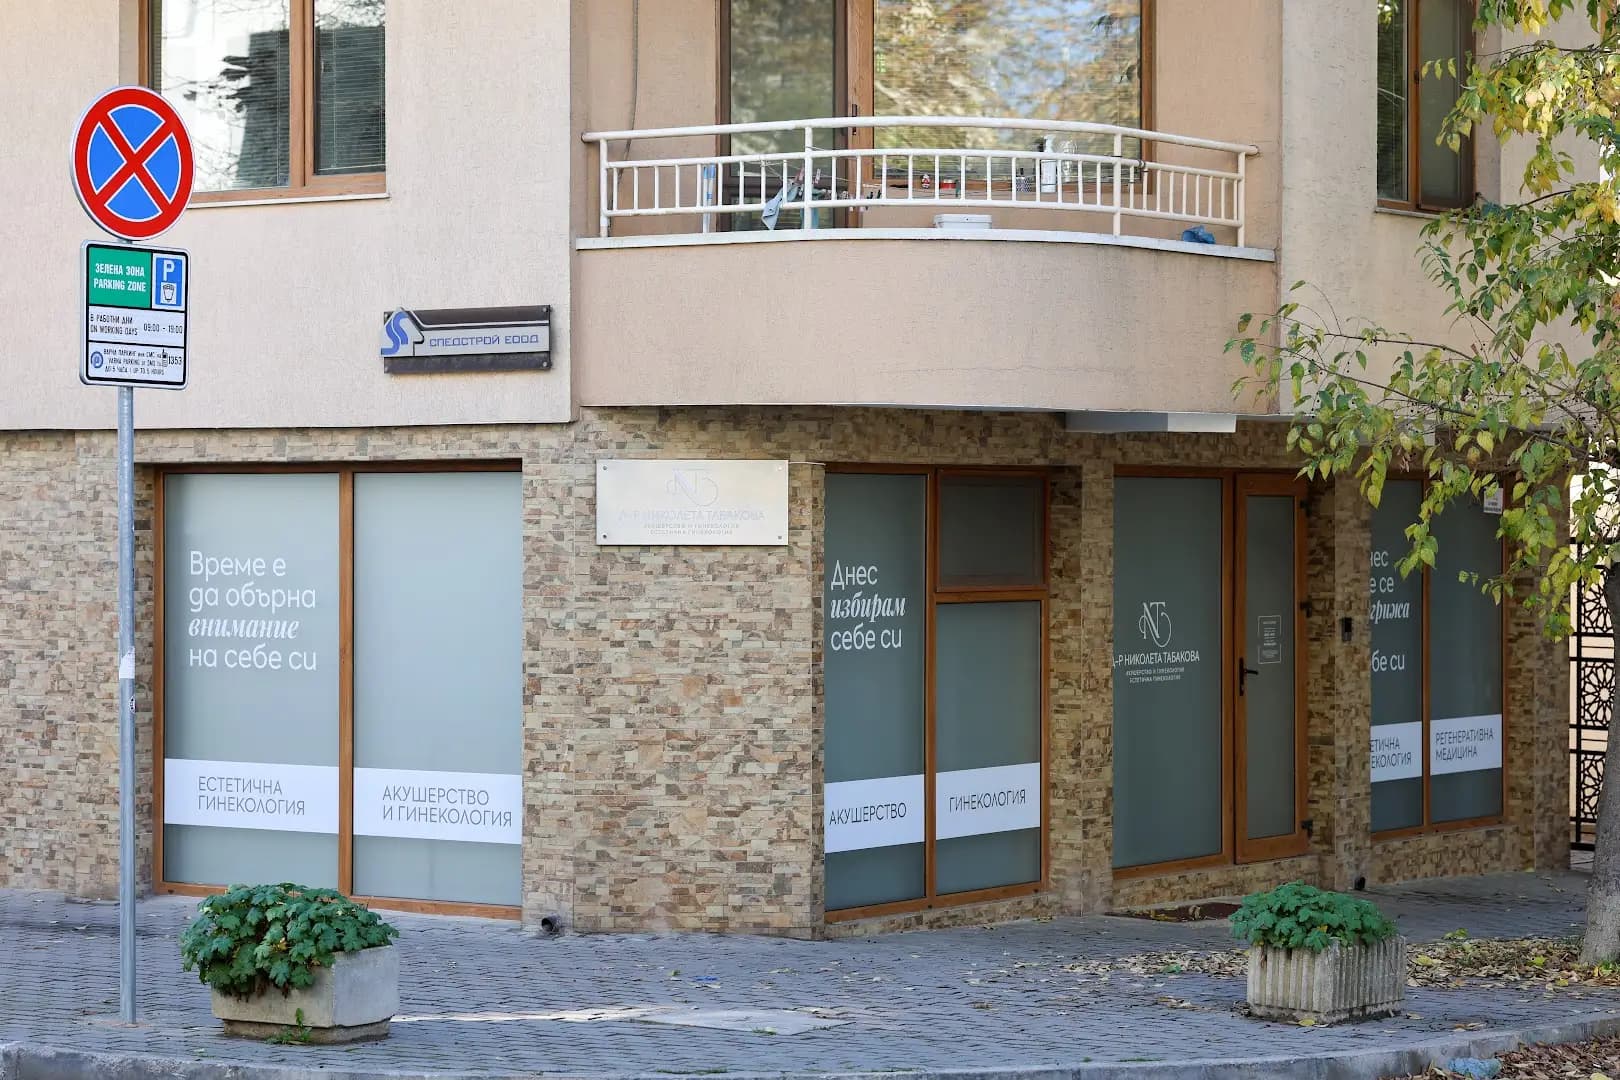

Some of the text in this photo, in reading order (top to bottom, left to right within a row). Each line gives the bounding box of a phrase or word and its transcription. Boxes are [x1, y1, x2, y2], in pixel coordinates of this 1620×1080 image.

[95, 263, 145, 277] ЗЕЛЕНА ЗОНА
[163, 260, 175, 282] P
[93, 278, 146, 292] PARKING ZONE
[96, 314, 120, 323] РАБОТНИ
[121, 316, 133, 324] ДНИ
[99, 325, 123, 335] WORKING
[124, 327, 138, 336] DAYS
[429, 334, 539, 347] СПЕДСТРОЙ ЕООД
[168, 355, 182, 365] 1353
[190, 550, 286, 582] Време е
[831, 559, 878, 591] Днес
[1380, 576, 1394, 593] се
[189, 581, 316, 614] да обърна
[830, 590, 906, 623] избирам
[1369, 599, 1410, 624] грижа
[188, 616, 300, 639] внимание
[830, 622, 902, 651] себе си
[189, 642, 317, 671] на себе си
[1124, 652, 1162, 666] НИКОЛЕТА
[1163, 650, 1200, 663] ТАБАКОВА
[1371, 649, 1405, 672] бе си
[1369, 736, 1400, 752] ЕТИЧНА
[1435, 728, 1494, 745] РЕГЕНЕРАТИВНА
[1371, 752, 1411, 768] ЕКОЛОГИЯ
[1435, 746, 1478, 761] МЕДИЦИНА
[198, 776, 282, 795] ЕСТЕТИЧНА
[382, 785, 490, 805] АКУШЕРСТВО
[198, 795, 305, 816] ГИНЕКОЛОГИЯ
[950, 789, 1026, 813] ГИНЕКОЛОГИЯ
[383, 805, 512, 828] И ГИНЕКОЛОГИЯ
[829, 802, 907, 826] АКУШЕРСТВО
